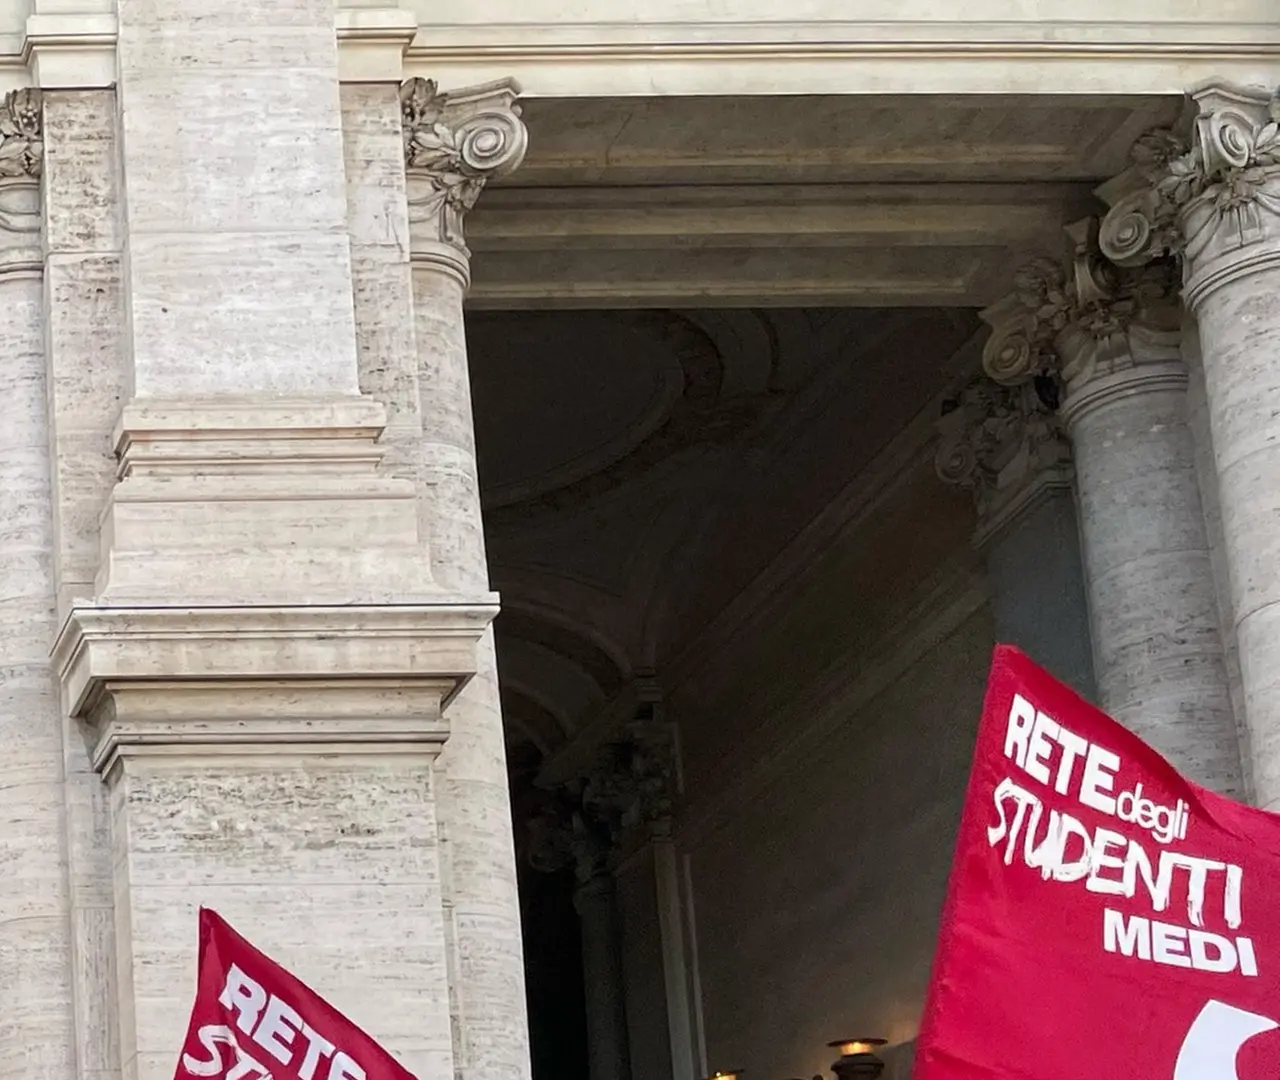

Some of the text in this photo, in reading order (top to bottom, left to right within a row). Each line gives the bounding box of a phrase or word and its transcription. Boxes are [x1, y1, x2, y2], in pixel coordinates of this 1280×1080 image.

[1004, 693, 1190, 843] RETE degli
[987, 776, 1243, 929] STUDENTI
[1103, 907, 1258, 976] MEDI
